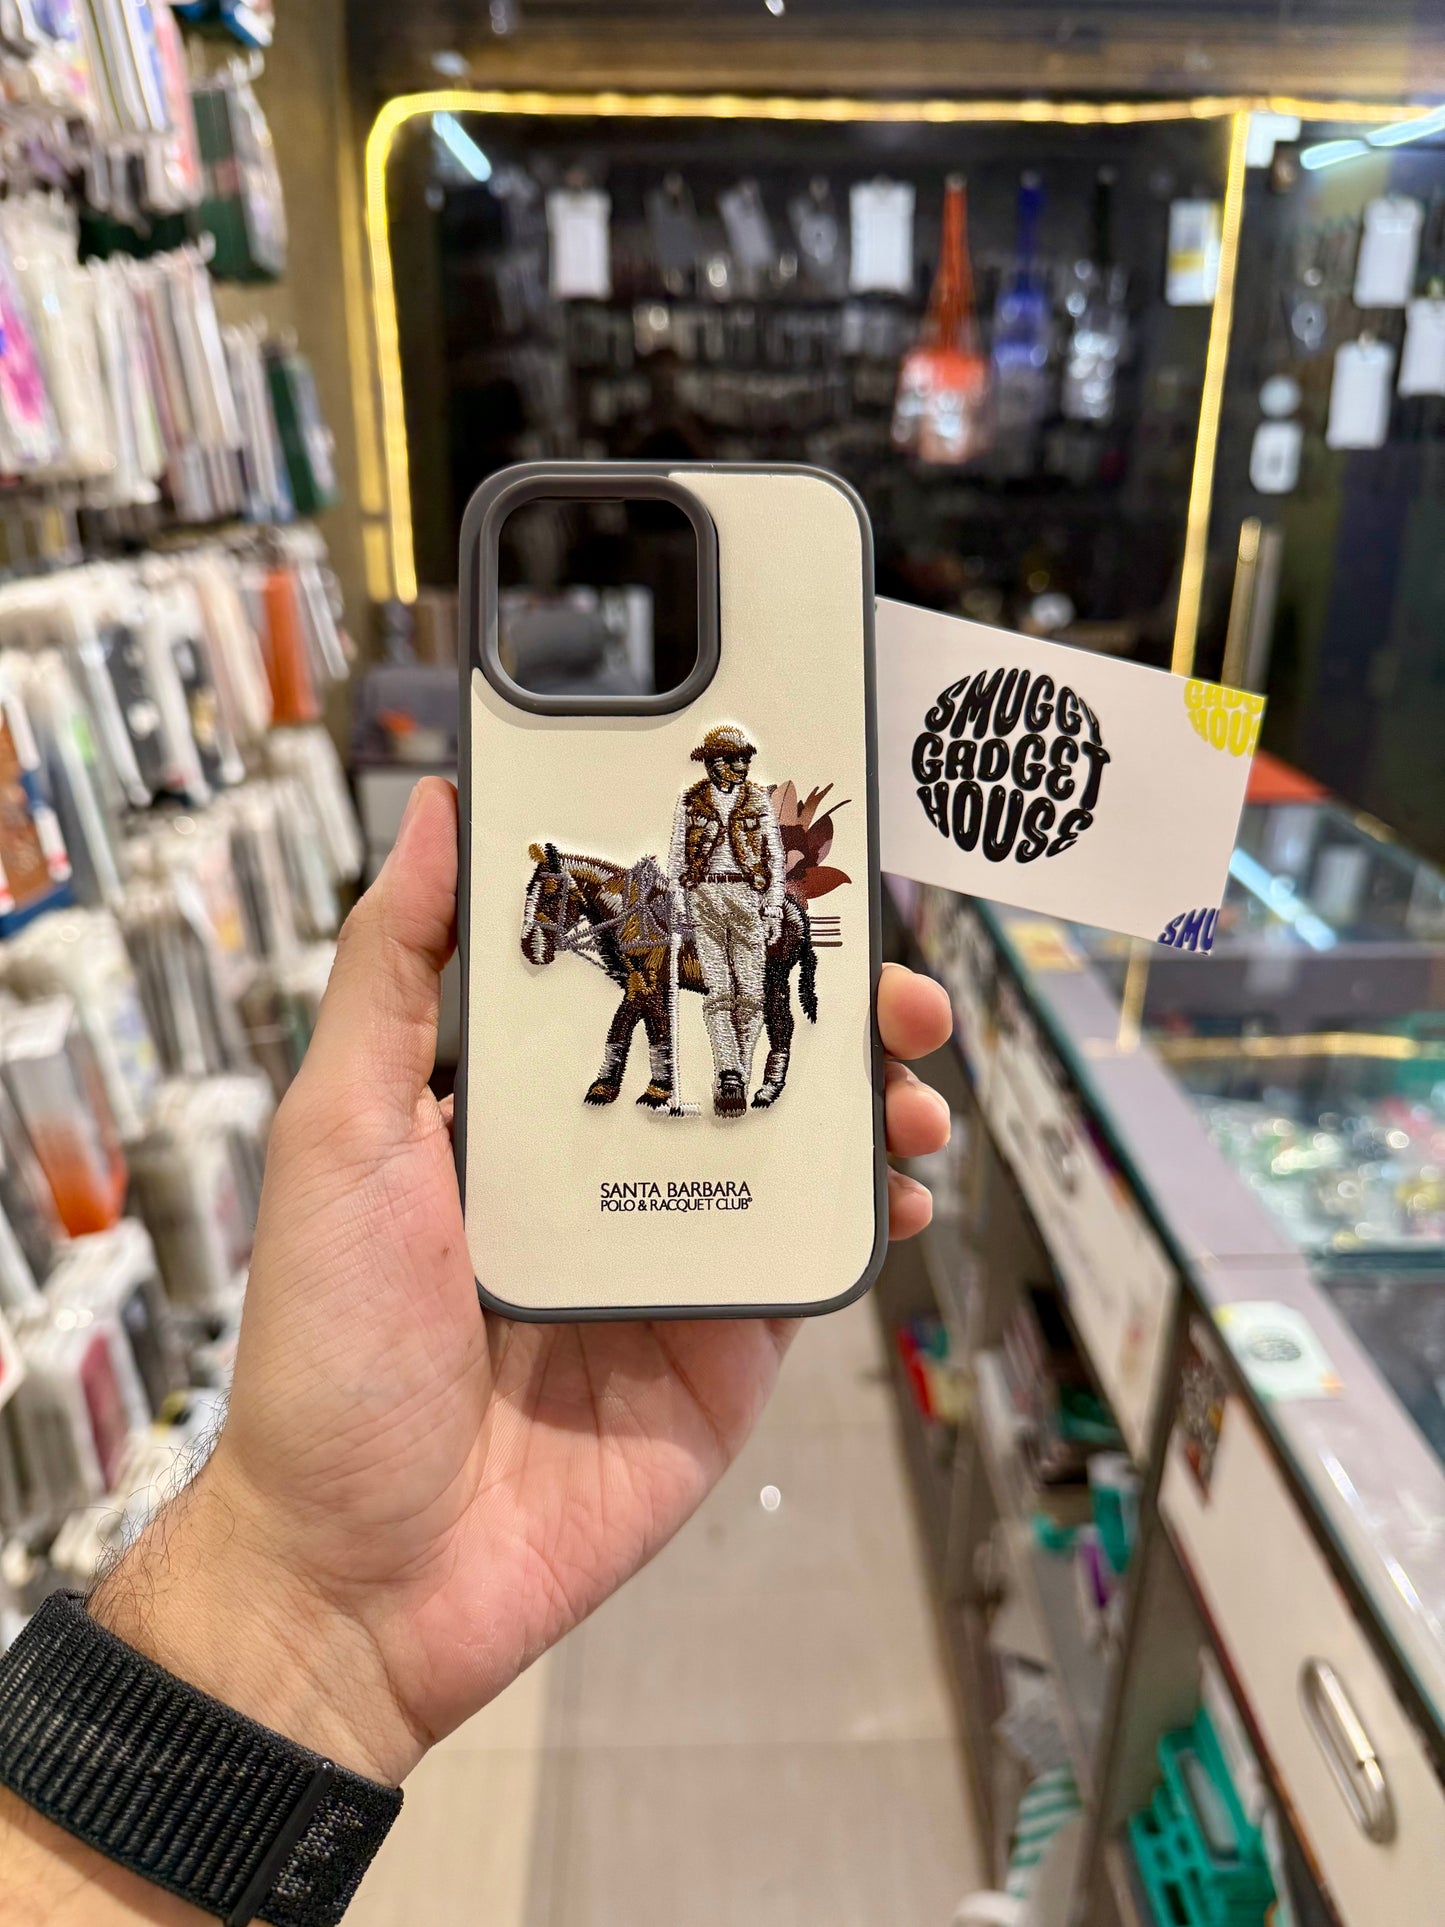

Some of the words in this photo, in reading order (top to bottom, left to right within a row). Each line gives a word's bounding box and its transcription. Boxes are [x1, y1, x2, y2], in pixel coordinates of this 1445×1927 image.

[1187, 707, 1261, 758] HOU
[911, 731, 1111, 811] GADGET
[916, 780, 1094, 864] HOUSE
[600, 1182, 662, 1199] SANTA
[667, 1181, 752, 1198] BARBARA
[600, 1199, 636, 1212] POLO
[637, 1199, 648, 1211] &
[649, 1198, 714, 1213] RACQUET
